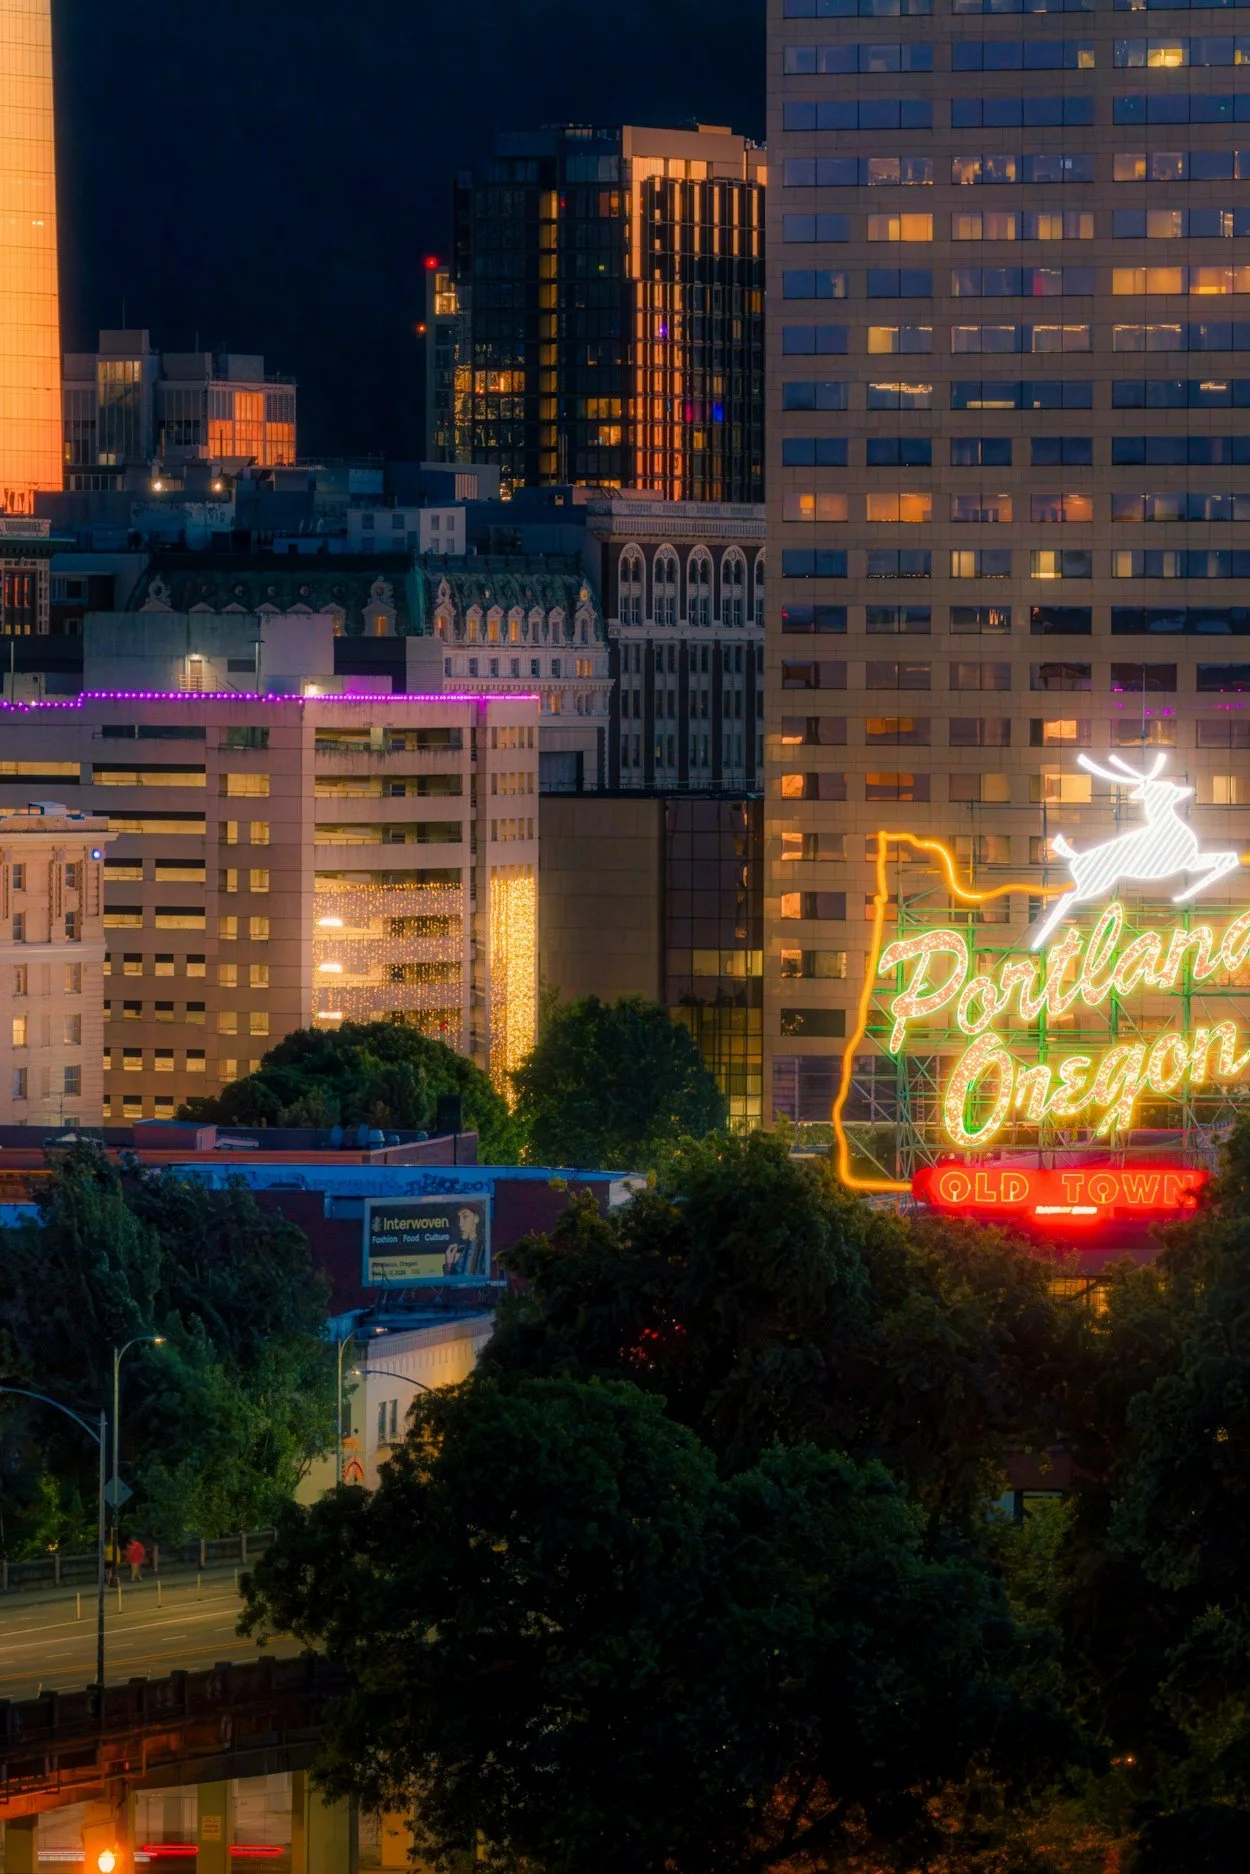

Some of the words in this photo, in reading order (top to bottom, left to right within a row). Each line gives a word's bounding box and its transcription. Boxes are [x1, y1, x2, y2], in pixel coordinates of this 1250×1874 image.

[944, 1021, 1250, 1147] Oregon
[939, 1171, 1030, 1202] OLD
[1062, 1173, 1194, 1205] TOWN
[383, 1217, 450, 1231] Interwoven
[372, 1235, 398, 1244] Fashion
[403, 1234, 420, 1243] Food
[424, 1233, 450, 1242] Culture
